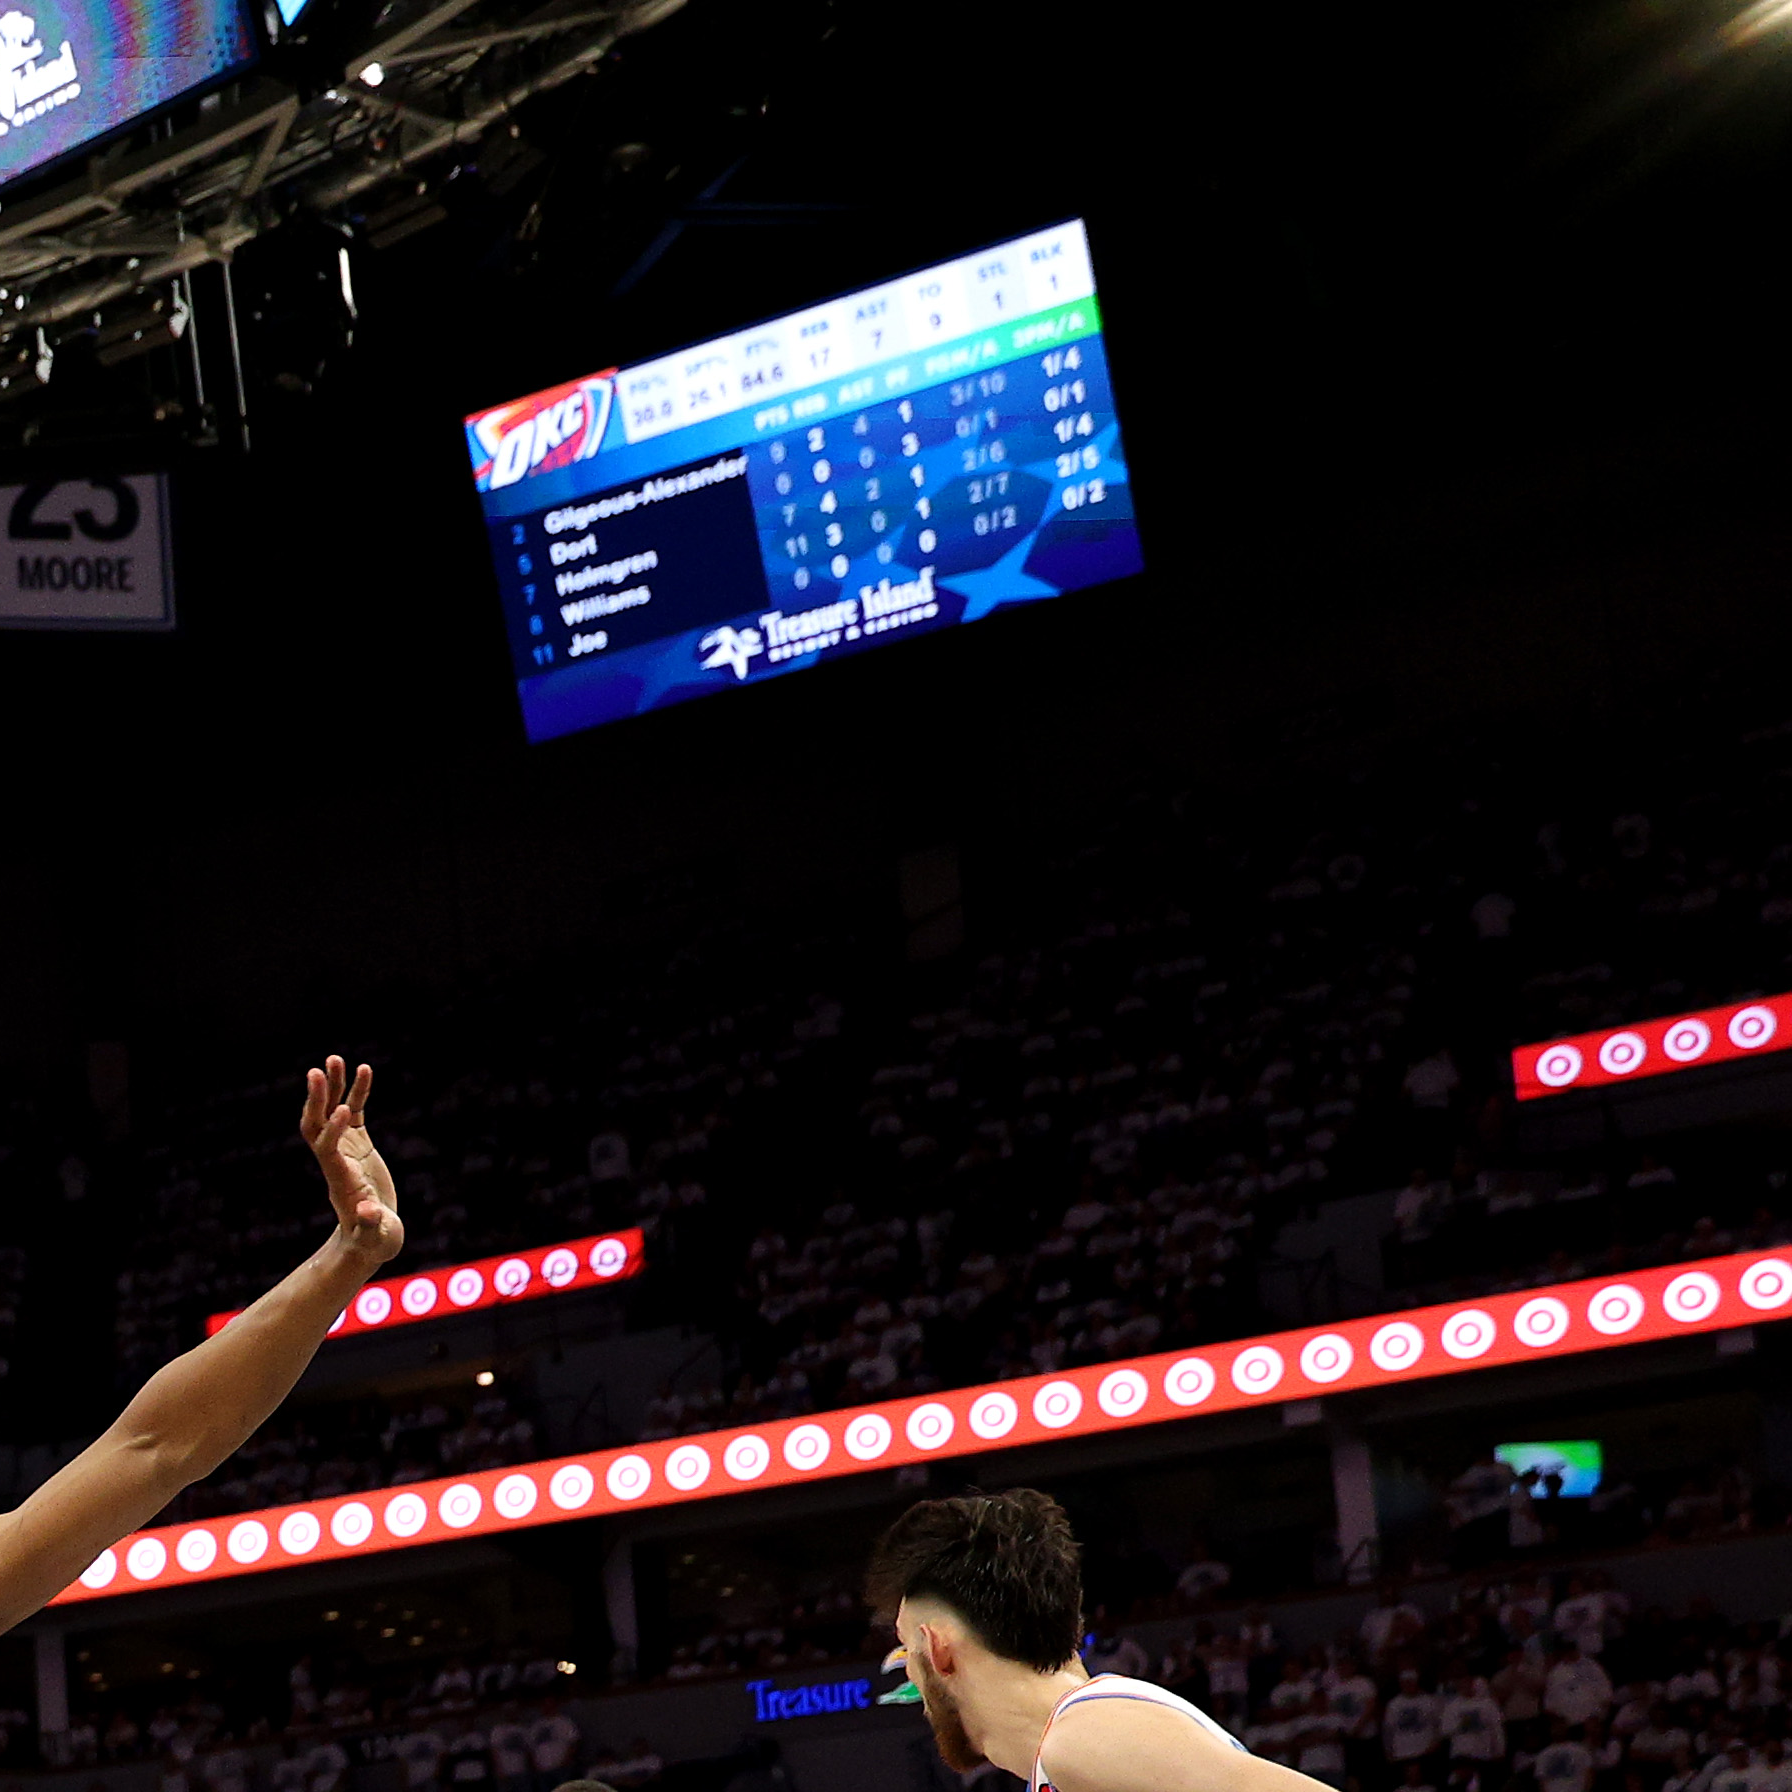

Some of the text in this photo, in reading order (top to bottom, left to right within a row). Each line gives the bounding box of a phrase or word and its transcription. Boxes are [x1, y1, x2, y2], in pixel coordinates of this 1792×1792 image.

[490, 392, 583, 492] OKC
[543, 345, 1082, 534] Gilgeous-Alexander 2 1 1/4
[549, 379, 1085, 565] Dort 0 3 0/1
[9, 478, 141, 541] 23
[554, 411, 1093, 596] Holmgren 4 1 1/4
[559, 584, 651, 626] Williams
[825, 522, 842, 547] 3
[915, 496, 930, 519] 1
[17, 556, 134, 593] MOORE
[568, 630, 607, 657] Joe
[830, 553, 849, 578] 0
[918, 528, 936, 553] 0
[1061, 477, 1105, 510] 0/2
[757, 563, 940, 650] Treasure Island
[746, 1678, 872, 1722] Treasure
